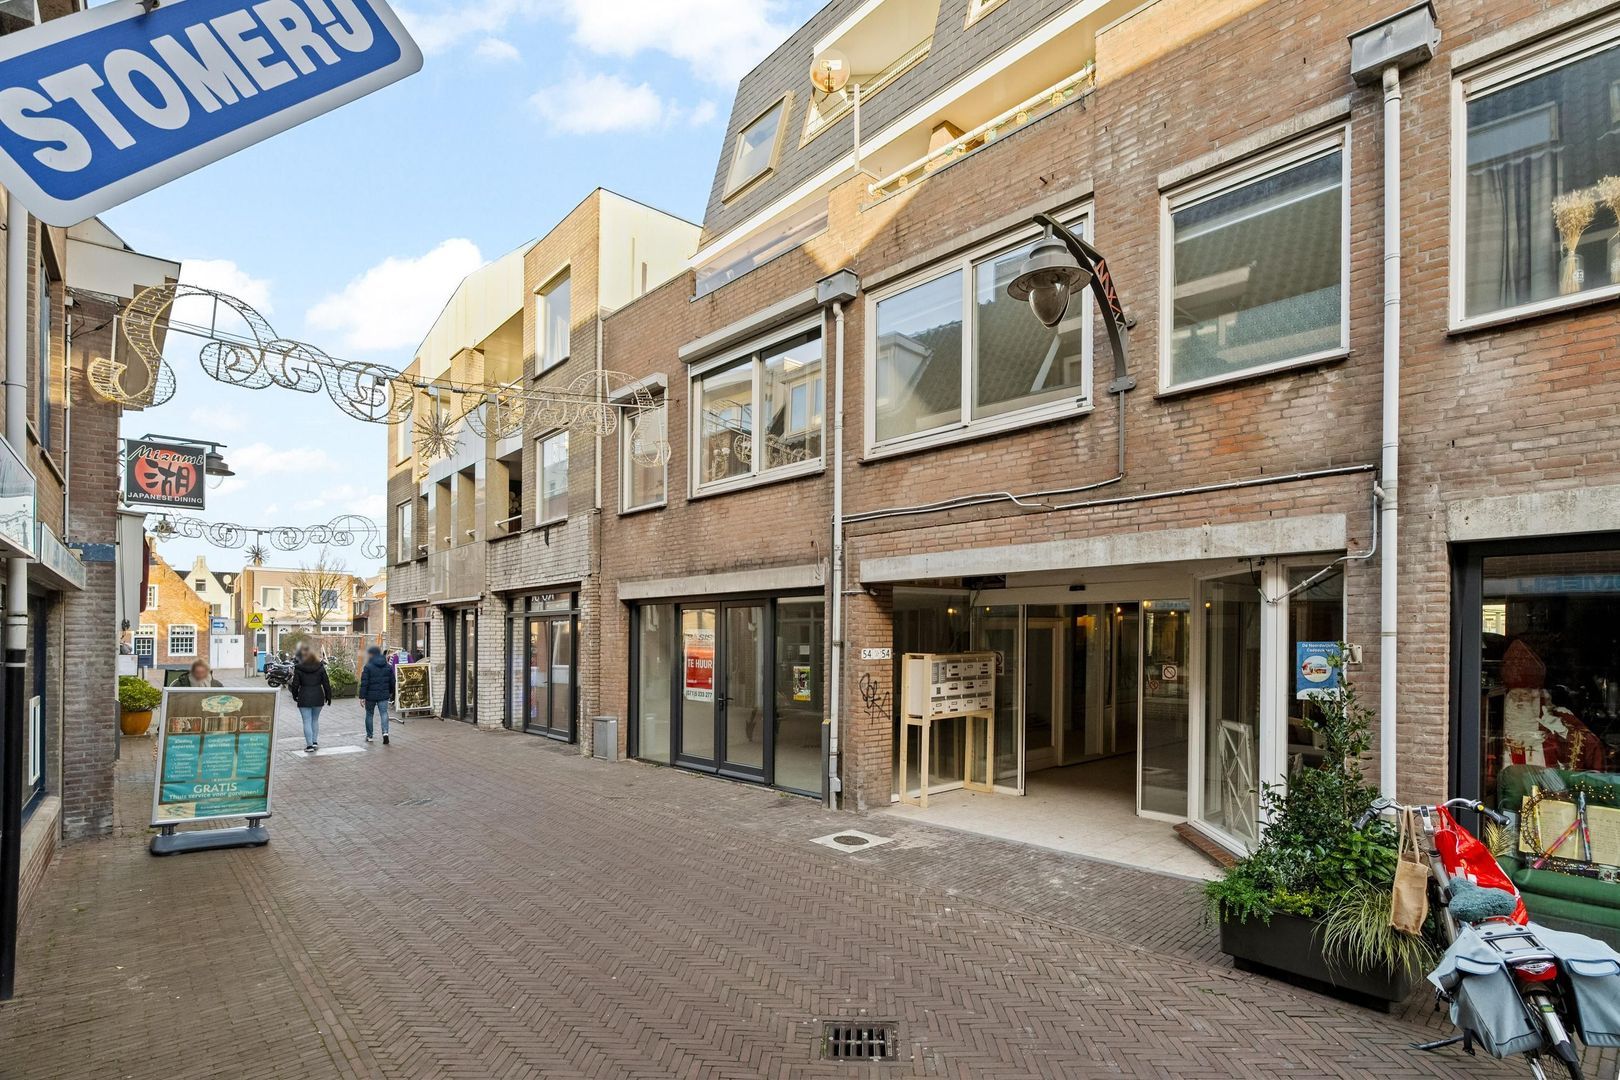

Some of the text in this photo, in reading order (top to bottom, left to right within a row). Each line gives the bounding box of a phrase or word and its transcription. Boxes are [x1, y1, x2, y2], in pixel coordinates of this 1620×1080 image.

[0, 0, 374, 173] STOMERIJ
[127, 444, 204, 466] Mizumi
[127, 492, 203, 504] JAPANESE DINING
[863, 649, 872, 659] 54
[881, 649, 890, 659] 54
[687, 659, 713, 669] TE HUUR
[193, 782, 238, 794] GRATIS
